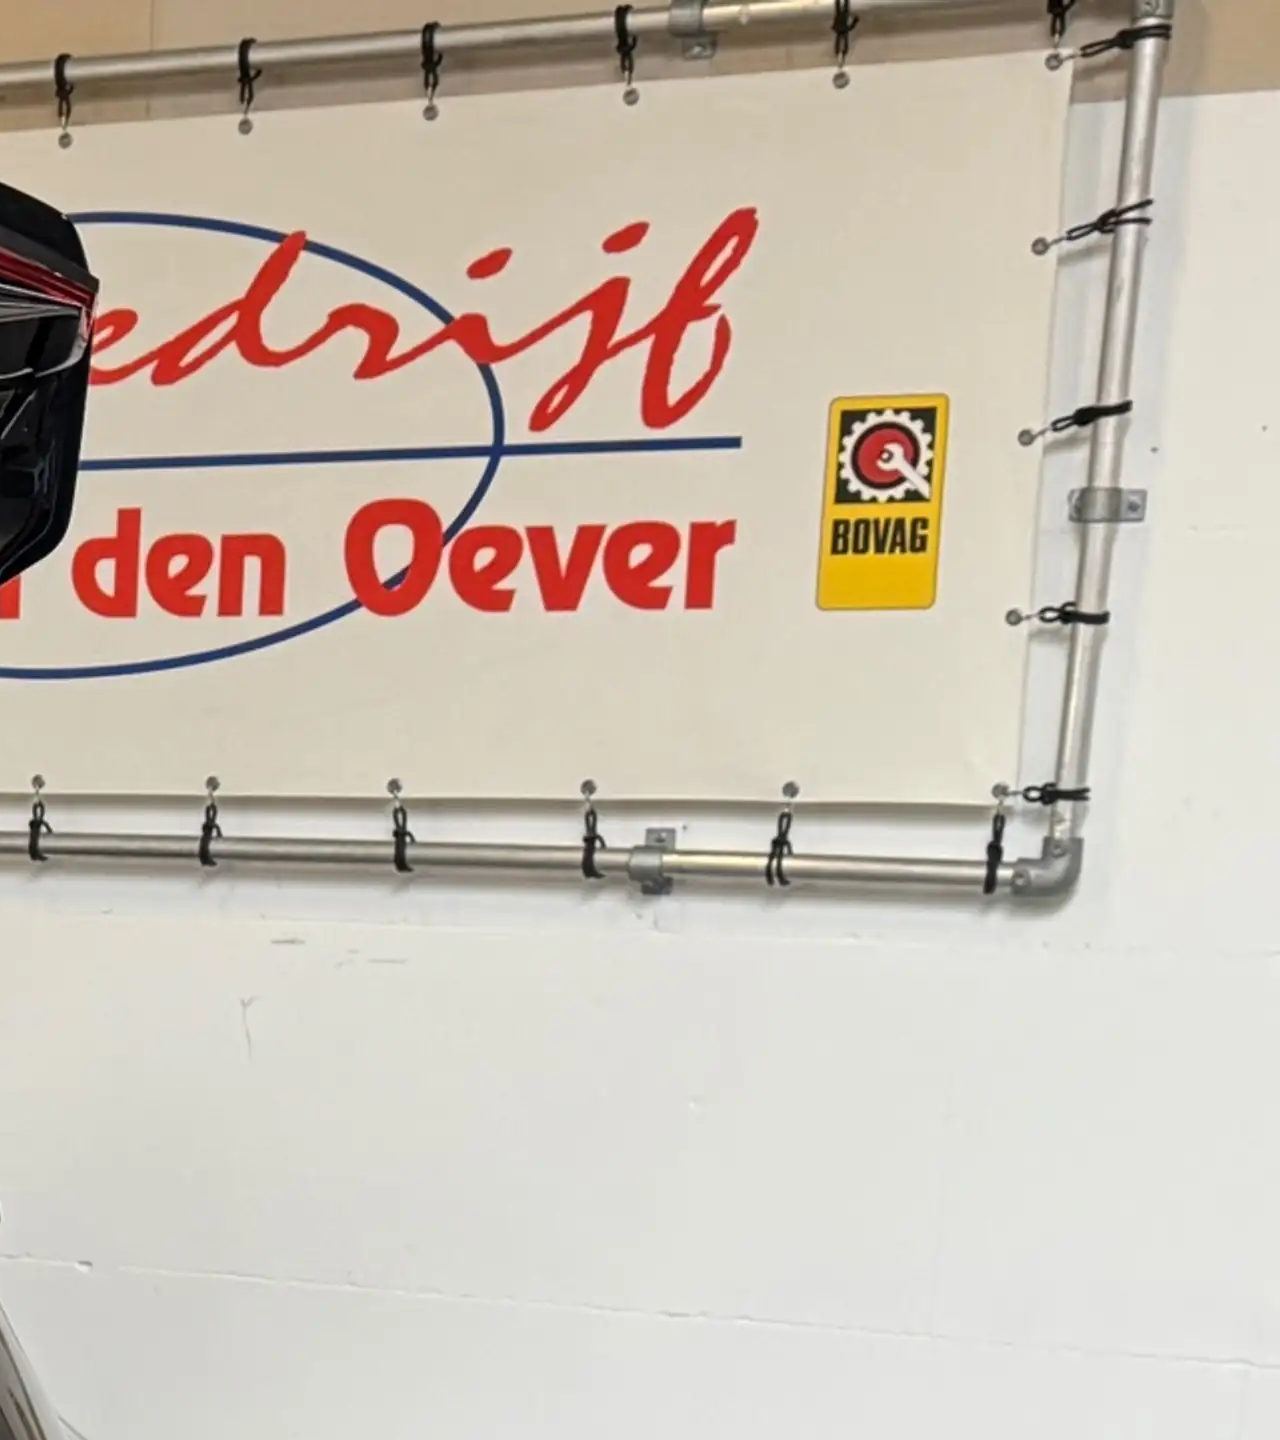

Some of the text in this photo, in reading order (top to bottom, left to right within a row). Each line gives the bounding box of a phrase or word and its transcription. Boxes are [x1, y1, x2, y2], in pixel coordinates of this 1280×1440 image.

[88, 207, 759, 433] edrijf
[71, 507, 288, 620] den
[343, 498, 737, 618] Oever
[830, 516, 930, 555] BOVAG
